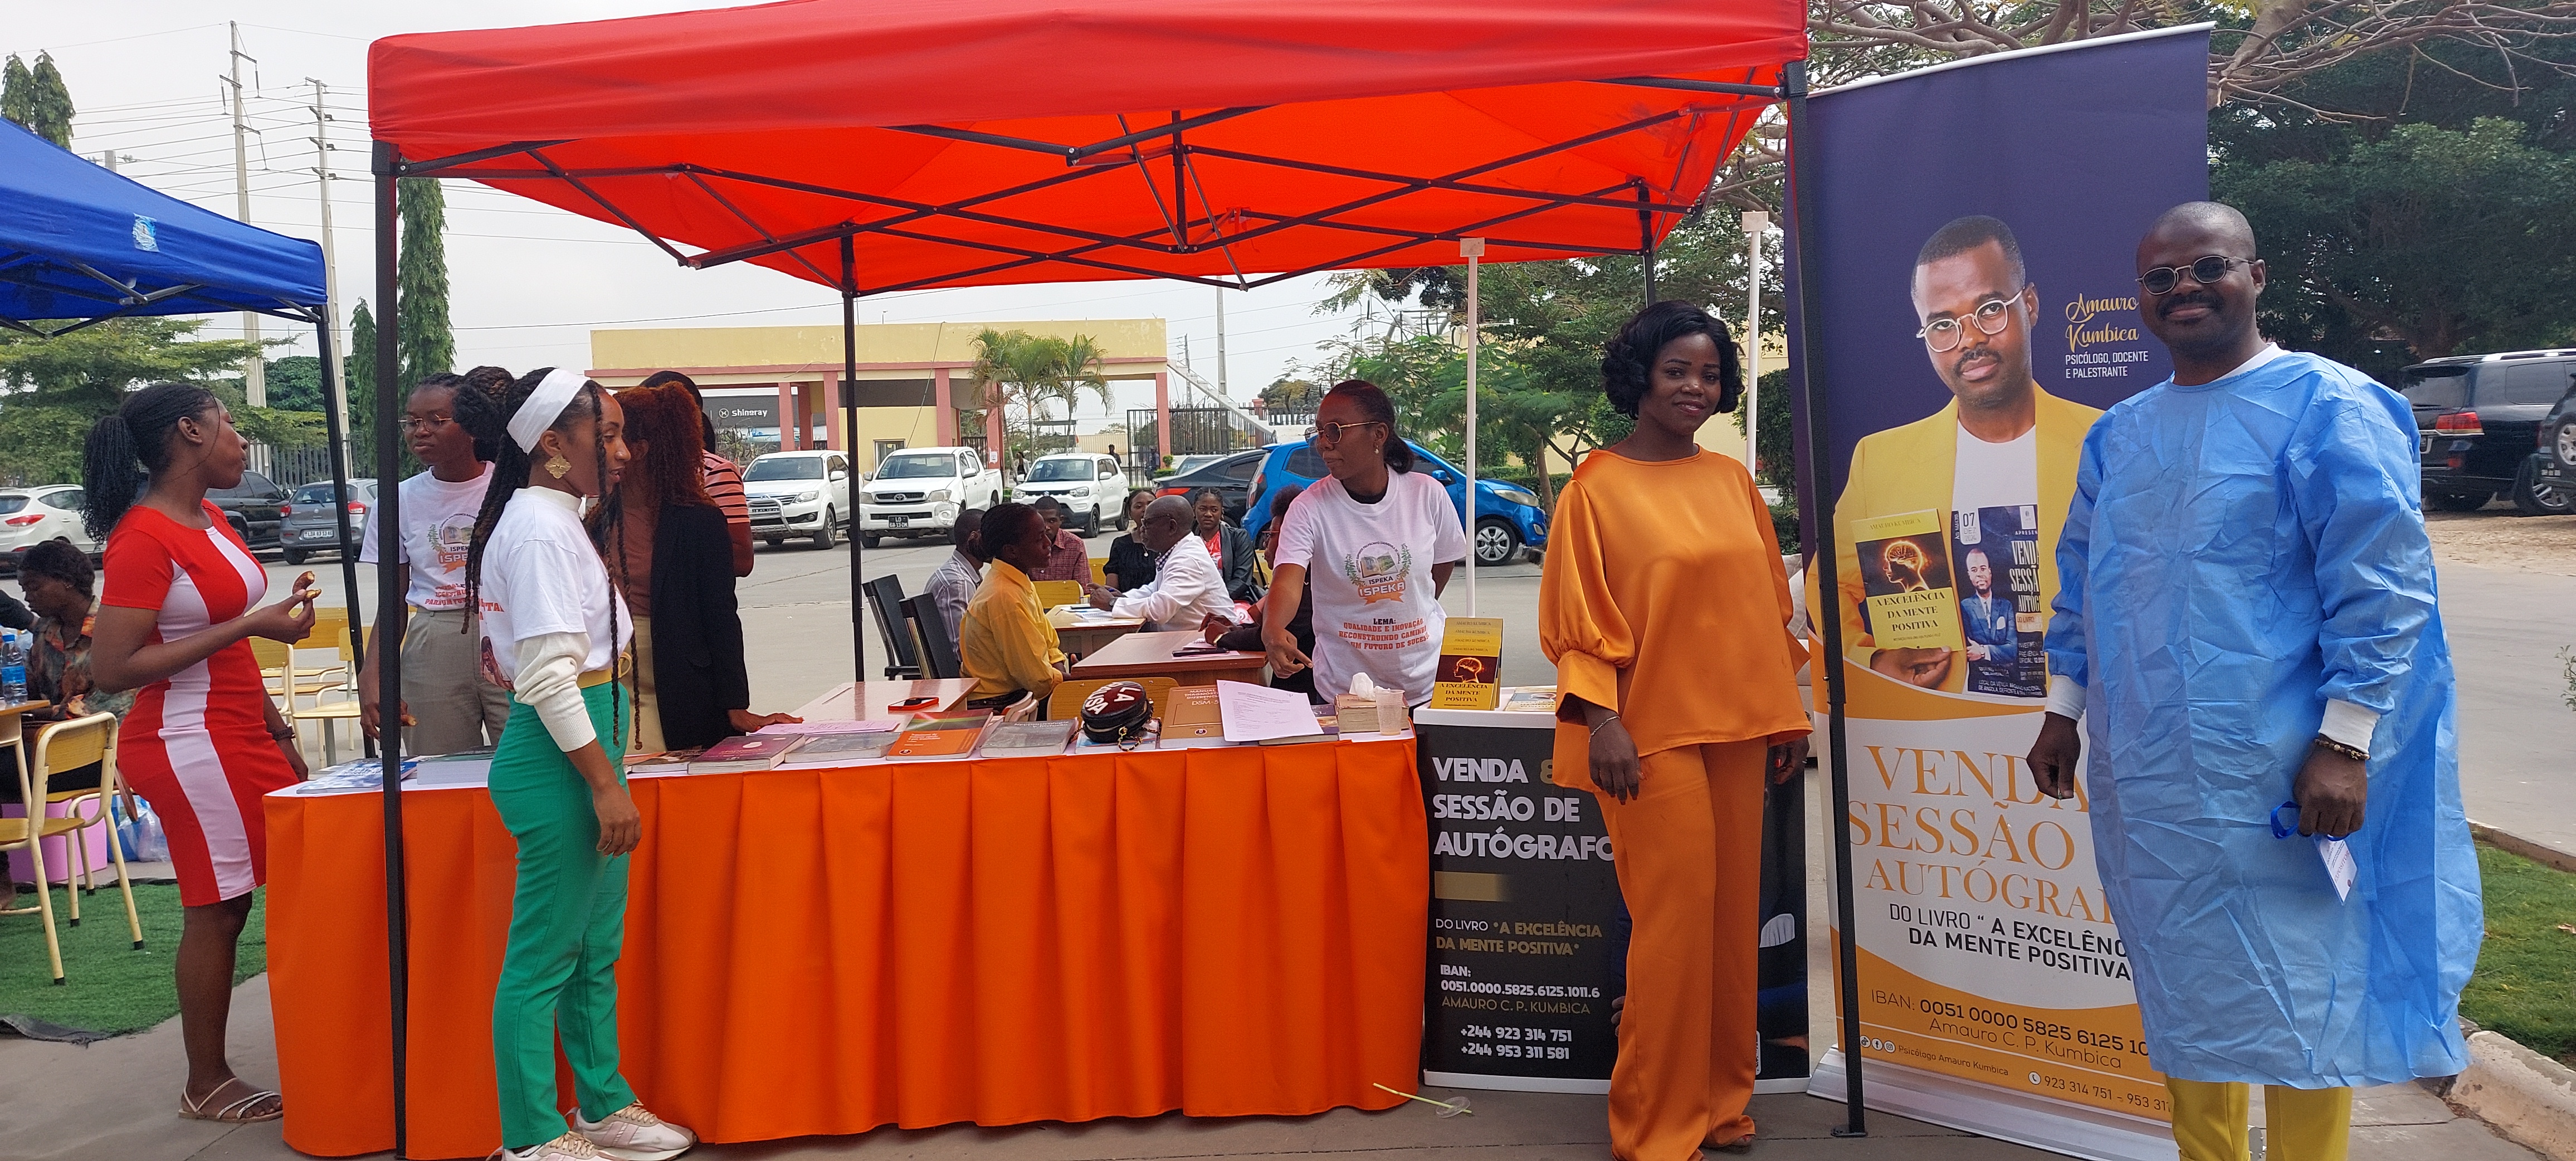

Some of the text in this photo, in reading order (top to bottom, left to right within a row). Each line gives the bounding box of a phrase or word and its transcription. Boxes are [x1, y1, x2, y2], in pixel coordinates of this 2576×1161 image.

[2066, 293, 2139, 323] Amauro
[2066, 322, 2139, 353] Kumbica
[2066, 350, 2149, 365] PSICÓLOGO, DOCENTE
[2066, 366, 2128, 379] E PALESTRANTE
[1963, 512, 1975, 527] 07
[1369, 576, 1393, 585] ISPEKA
[1359, 582, 1404, 597] ISPEKA
[1885, 592, 1945, 606] EXCELÊNCIA
[1887, 606, 1938, 619] DA MENTE
[1343, 622, 1382, 632] QUALIDADE
[1392, 618, 1423, 631] INOVAÇÃO
[1892, 619, 1939, 631] POSITIVA
[1339, 631, 1398, 641] RECONSTRUINDO
[1085, 682, 1124, 715] PAUSA
[1114, 687, 1141, 702] LA
[1432, 757, 1529, 783] VENDA
[1433, 789, 1580, 822] SESSÃO DE
[1433, 826, 1615, 861] AUTÓGRAFO
[1848, 800, 2075, 870] SESSÃO
[1890, 903, 1911, 922] DO
[1919, 908, 1970, 929] LIVRO
[1991, 918, 2006, 936] A
[1436, 919, 1453, 929] DO
[1456, 920, 1488, 931] LIVRO
[1515, 920, 1602, 938] EXCELÊNCIA
[1436, 936, 1455, 949] DA
[1460, 938, 1504, 952] MENTE
[1909, 927, 2132, 981] DA MENTE POSITIVA
[1440, 964, 1471, 977] IBAN:
[1442, 996, 1591, 1014] AMAURO C. P. KUMBICA
[1871, 989, 1915, 1011] IBAN:
[1920, 999, 1963, 1018] 0051
[1969, 1007, 2018, 1029] 0000
[2023, 1018, 2071, 1041] 5825
[2077, 1029, 2124, 1051] 6125
[1461, 1025, 1572, 1042] +244 923 314 751
[1461, 1043, 1569, 1059] +244 953 311 581
[1929, 1017, 2121, 1069] Amauro C. P. Kumbica
[1899, 1045, 2008, 1076] Psicólogo Amauro Kumbica
[2045, 1076, 2065, 1090] 923
[2070, 1081, 2089, 1095] 314
[2092, 1086, 2112, 1100] 751
[2127, 1094, 2149, 1108] 953
